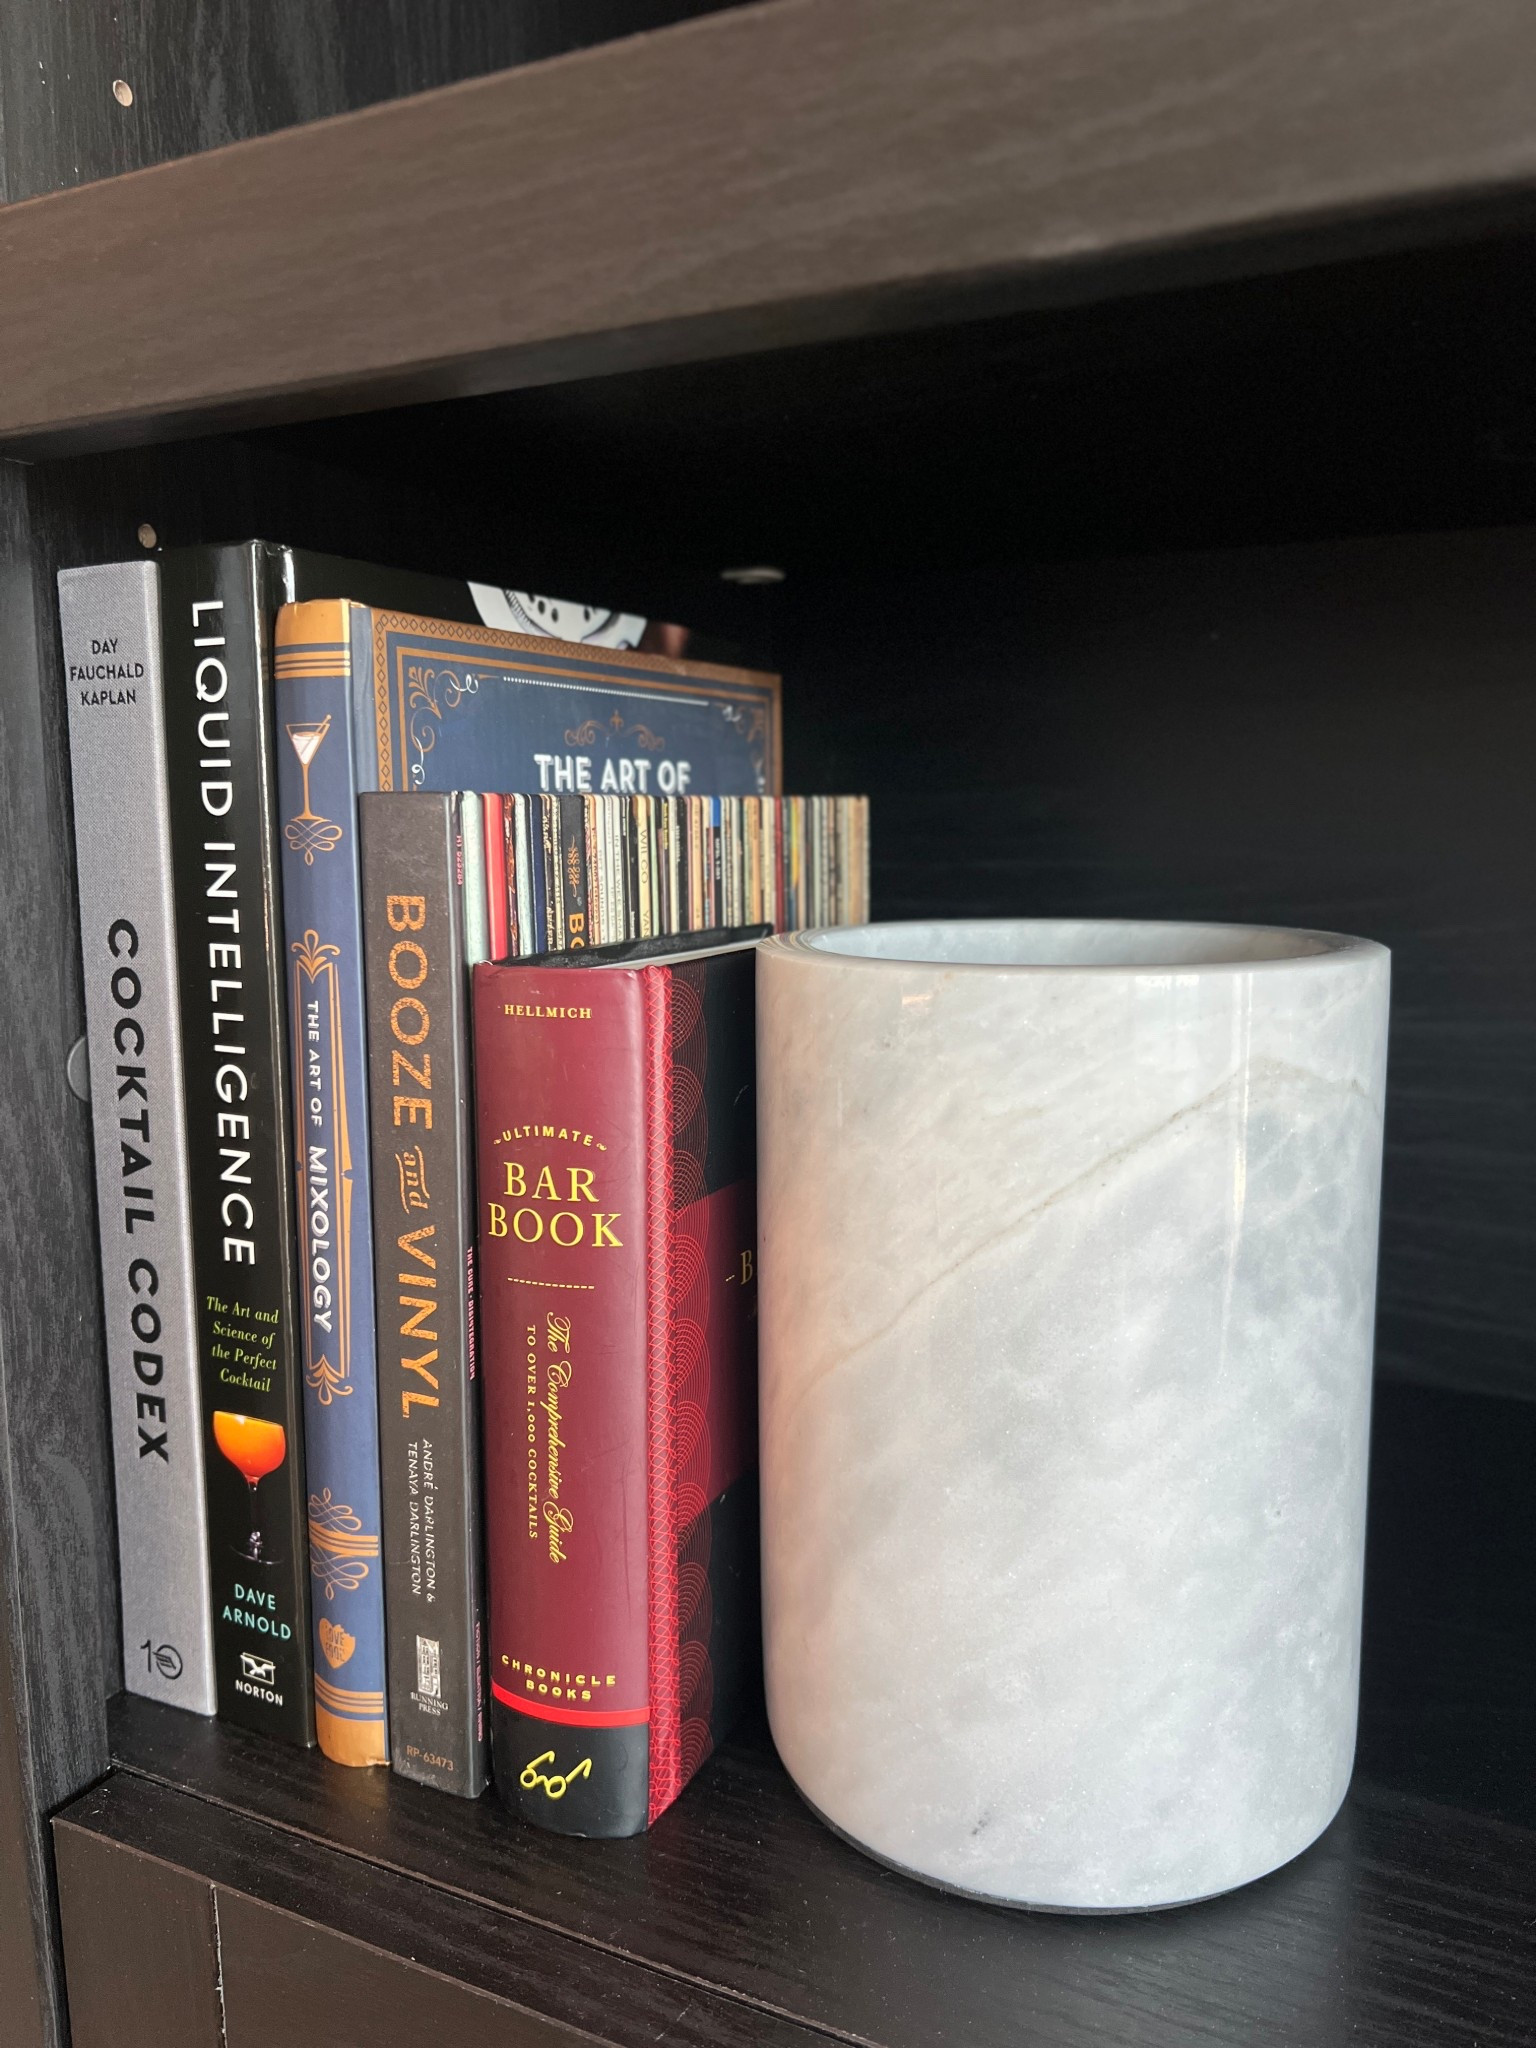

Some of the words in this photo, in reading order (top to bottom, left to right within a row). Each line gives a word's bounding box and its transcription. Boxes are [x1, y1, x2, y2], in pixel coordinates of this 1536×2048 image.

[91, 638, 118, 655] DAY
[70, 663, 144, 682] FAUCHALD
[81, 689, 136, 706] KAPLAN
[192, 601, 233, 816] LIQUID
[533, 753, 592, 793] THE
[601, 757, 652, 794] ART
[657, 759, 691, 794] OF
[640, 829, 649, 884] WILCO
[307, 1000, 320, 1042] THE
[386, 894, 433, 1130] BOOZE
[504, 1004, 592, 1020] HELLMICH
[204, 843, 256, 1266] INTELLIGENCE
[308, 1048, 322, 1092] ART
[107, 918, 155, 1235] COCKTAIL
[310, 1097, 323, 1128] OF
[502, 1125, 594, 1147] ULTIMATE
[403, 1151, 429, 1210] and
[503, 1161, 600, 1203] BAR
[308, 1145, 335, 1335] MIXOLOGY
[487, 1202, 624, 1248] BOOK
[206, 1295, 229, 1314] The
[232, 1301, 251, 1318] Art
[255, 1309, 279, 1324] and
[398, 1224, 440, 1419] VINYL
[212, 1320, 258, 1343] Science
[261, 1332, 276, 1350] of
[527, 1324, 537, 1347] TO
[546, 1311, 571, 1354] The
[127, 1258, 169, 1465] CODEX
[211, 1343, 231, 1360] the
[234, 1347, 277, 1371] Perfect
[527, 1352, 537, 1395] OVER
[220, 1367, 271, 1393] Cocktail
[526, 1401, 537, 1443] 1,000
[540, 1360, 573, 1500] Comprehensive
[407, 1441, 419, 1495] TENAYA
[422, 1437, 438, 1490] ANDRÉ
[527, 1448, 538, 1540] COCKTAILS
[409, 1501, 422, 1595] DARLINGTON
[424, 1495, 436, 1590] DARLINGTON
[543, 1501, 574, 1564] Guide
[234, 1583, 276, 1610] DAVE
[426, 1592, 437, 1603] &
[223, 1605, 291, 1640] ARNOLD
[501, 1654, 616, 1687] CHRONICLE
[526, 1679, 592, 1702] BOOKS
[235, 1679, 283, 1707] NORTON
[410, 1691, 449, 1711] RUNNING
[418, 1702, 441, 1716] PRESS
[406, 1744, 454, 1772] RP-63473
